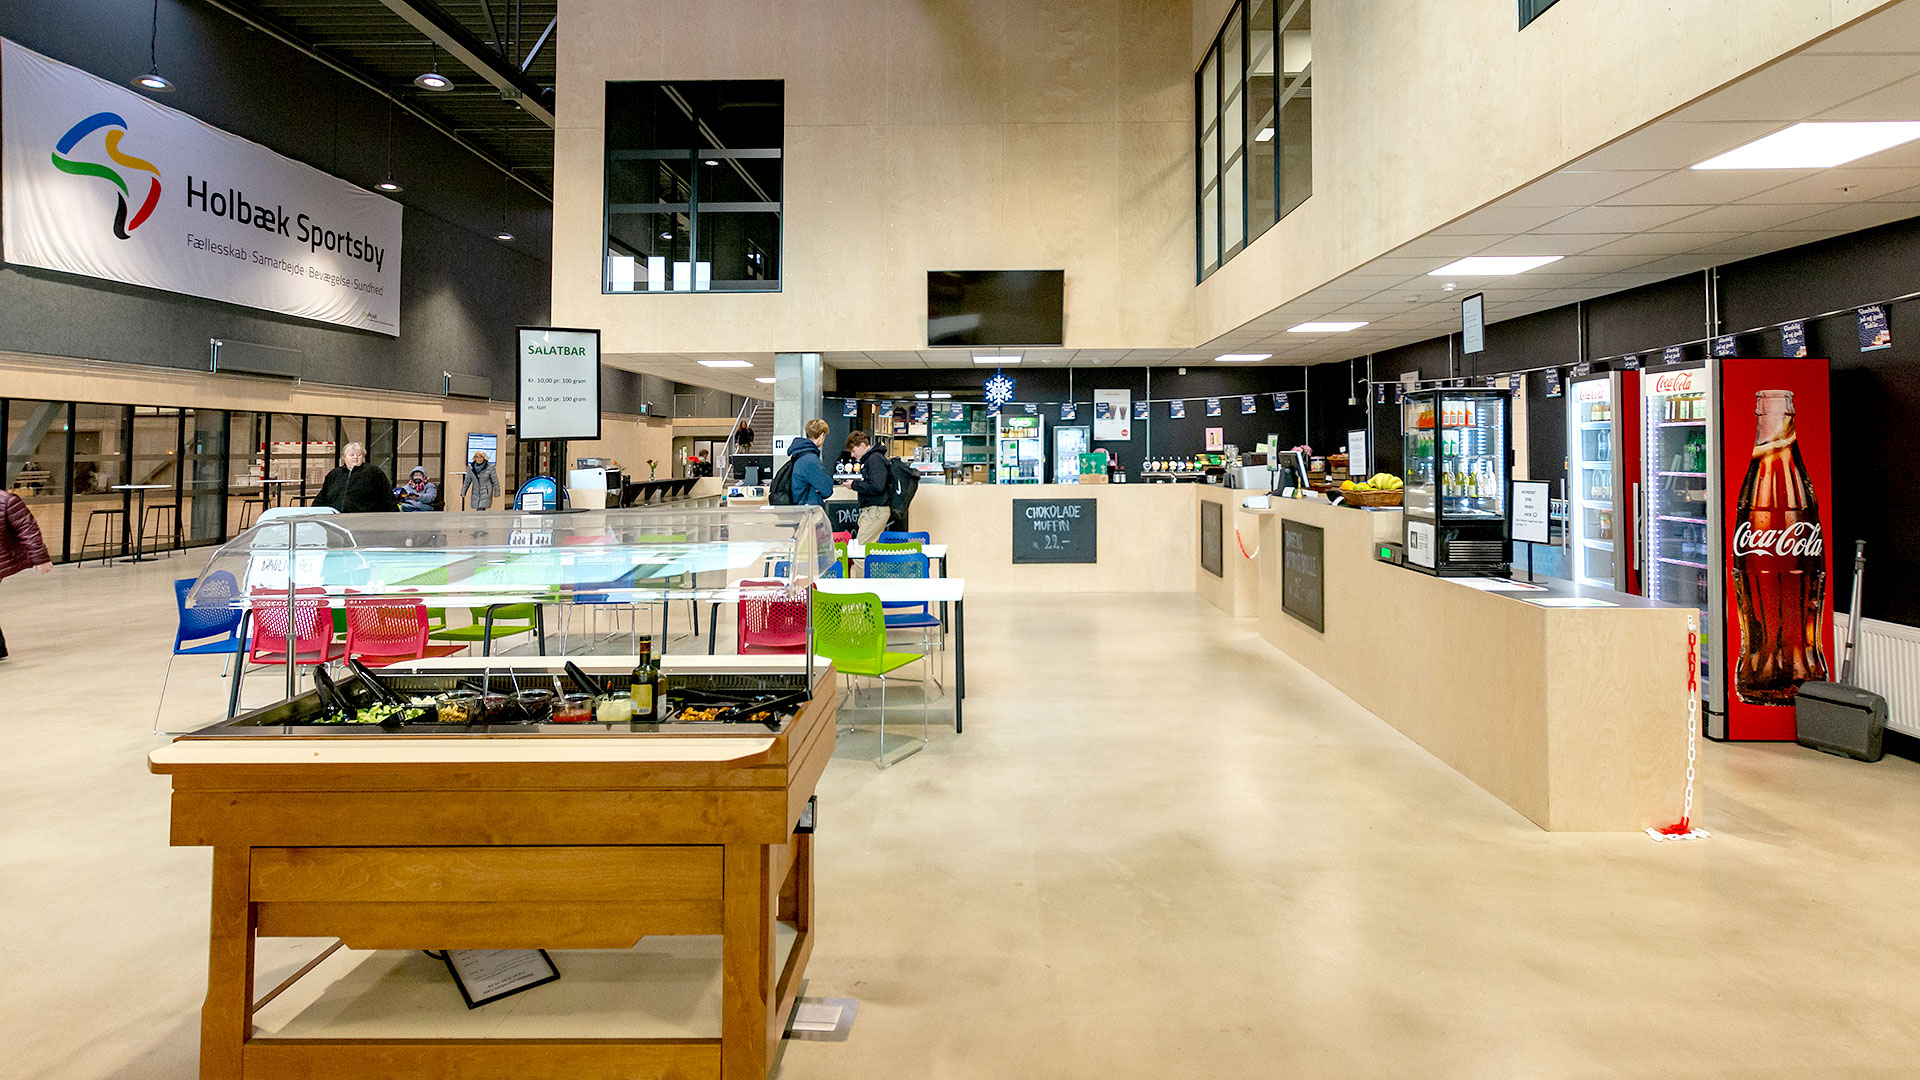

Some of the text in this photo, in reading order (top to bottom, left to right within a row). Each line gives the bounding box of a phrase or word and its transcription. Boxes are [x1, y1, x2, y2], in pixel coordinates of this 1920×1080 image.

[187, 176, 385, 273] Holbæk Sportsby
[187, 233, 384, 297] Fællesskab Samarbejde Bevægelse Sundhed
[527, 345, 586, 356] SALATBAR
[1025, 504, 1081, 519] CHOKOLADE
[1033, 519, 1070, 532] MUFFIN
[1733, 521, 1822, 556] Coca-Cola
